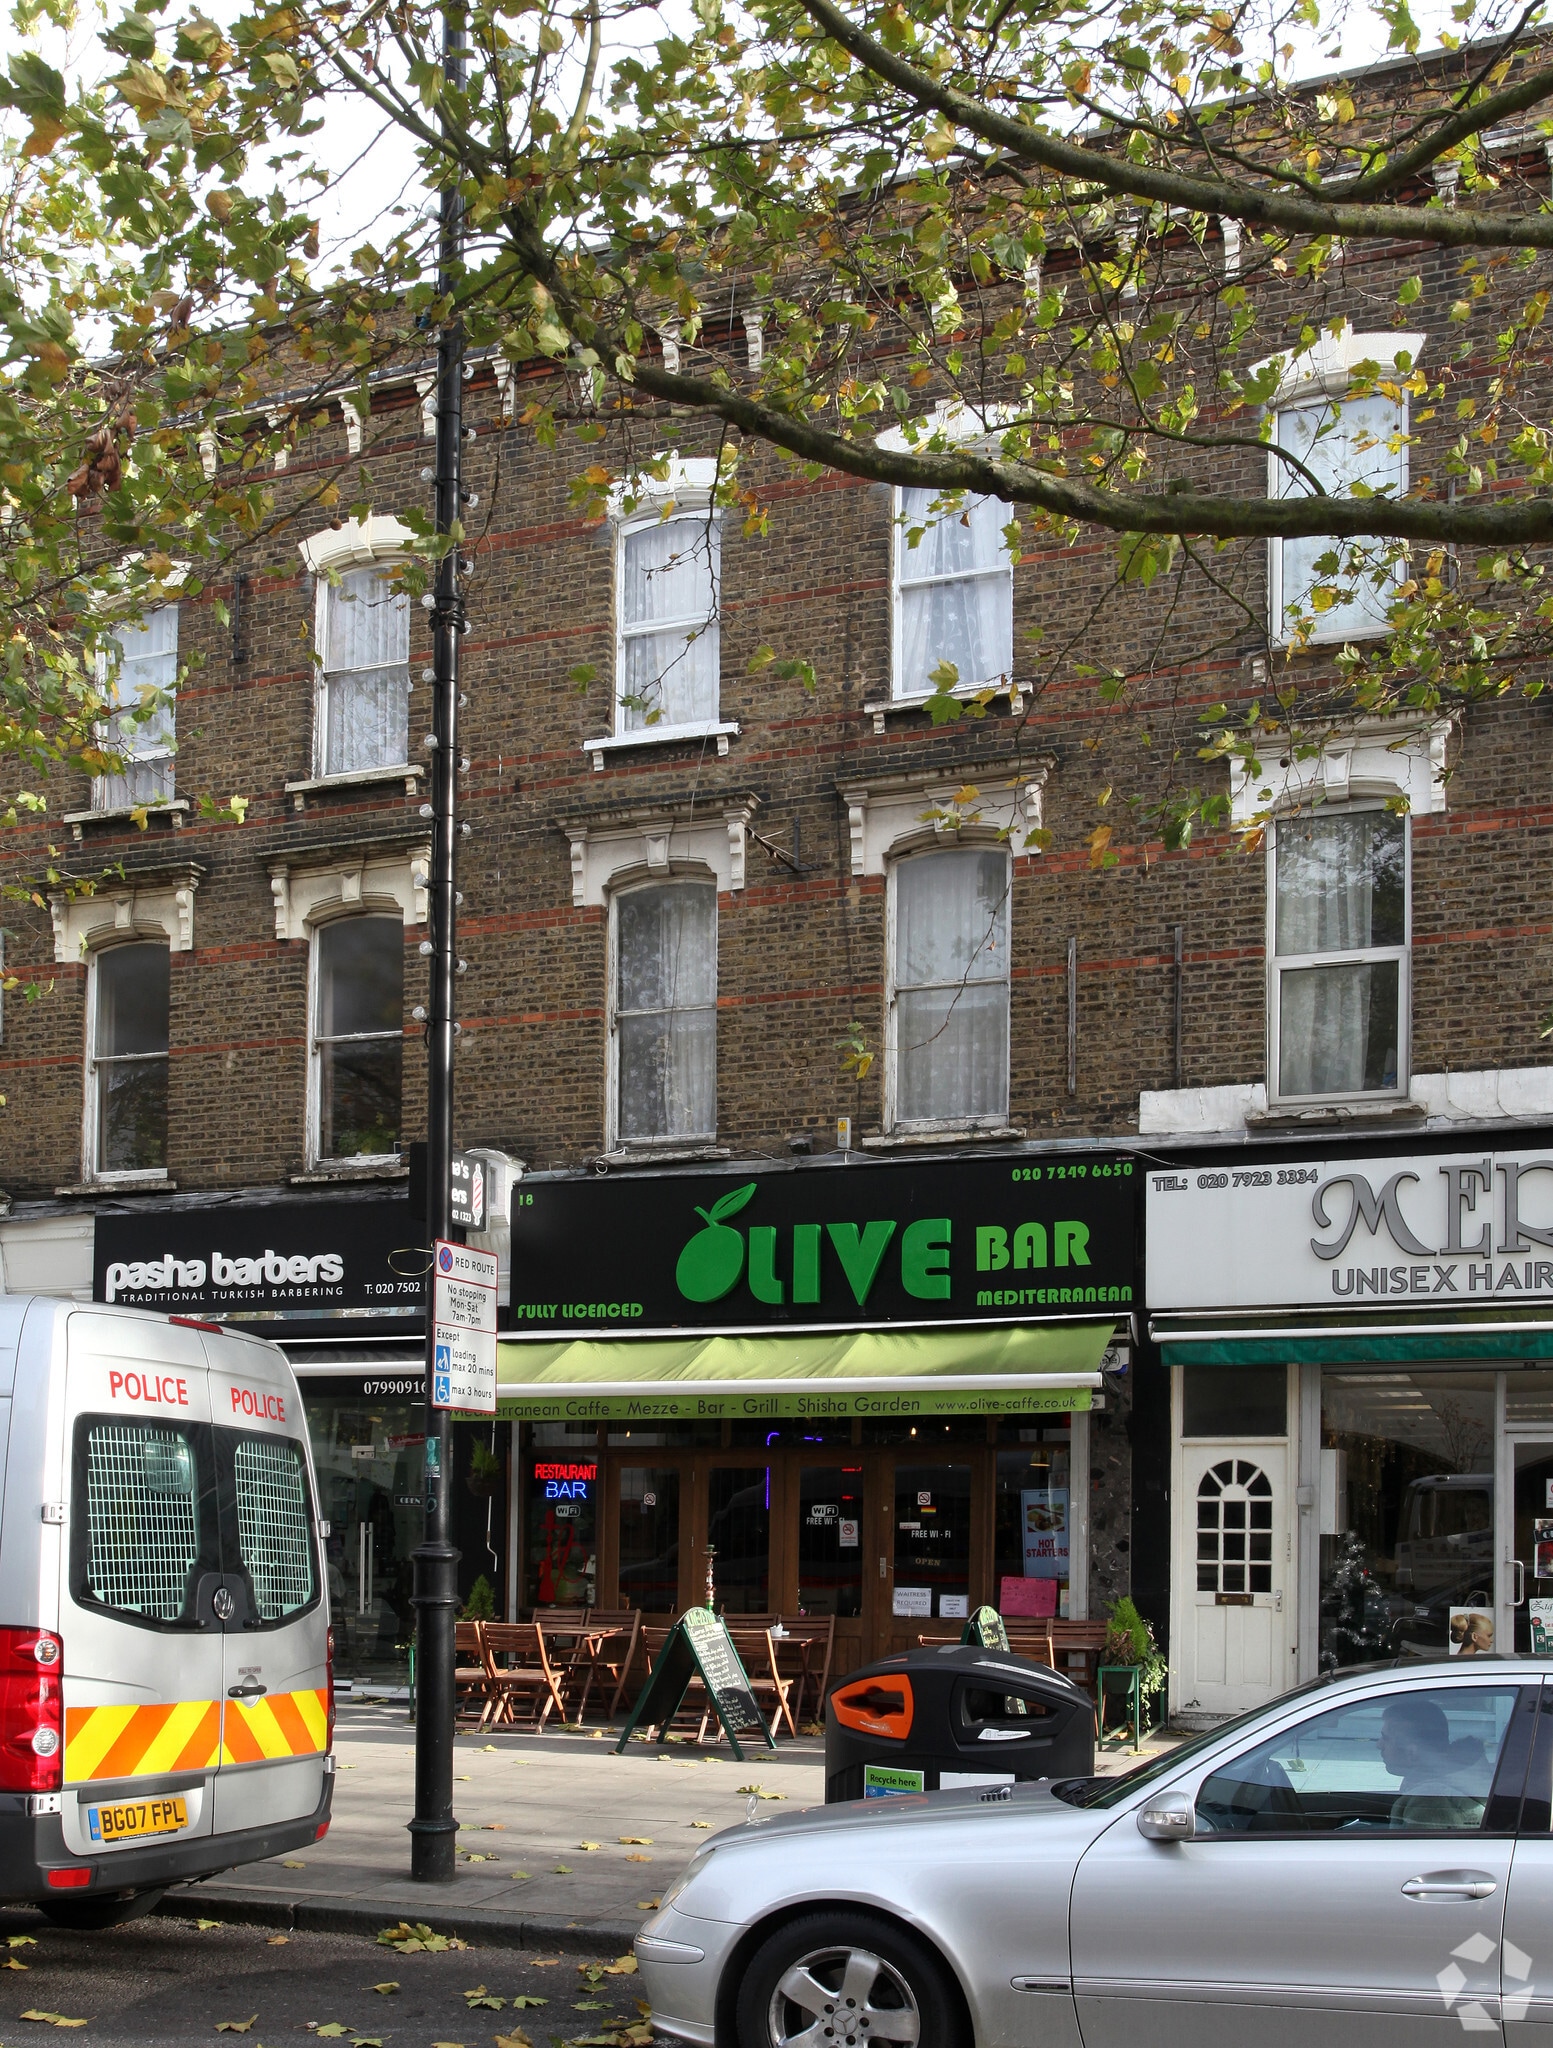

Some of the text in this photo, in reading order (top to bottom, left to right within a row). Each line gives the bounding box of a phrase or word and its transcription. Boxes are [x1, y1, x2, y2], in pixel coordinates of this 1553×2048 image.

[1012, 1163, 1133, 1182] 020 7249 6650
[1152, 1168, 1318, 1192] TEL: 020 7923 3334
[519, 1194, 533, 1206] 18
[460, 1211, 472, 1222] 1323
[676, 1205, 1092, 1307] OLIVE BAR
[455, 1256, 495, 1276] RED ROUTE
[105, 1249, 344, 1304] pasha barbers
[1332, 1265, 1458, 1296] UNISEX
[122, 1286, 344, 1303] TRADITIONAL TURKISH BARBERING
[375, 1283, 394, 1294] 020
[396, 1281, 421, 1293] 7502
[447, 1283, 487, 1303] No stopping
[976, 1286, 1133, 1306] MEDITERRANEAN
[450, 1297, 479, 1313] Mon-Sat
[518, 1302, 644, 1319] FULLY LICENCED
[451, 1310, 482, 1326] 7am-7pm
[436, 1328, 461, 1343] Except
[452, 1348, 477, 1363] loading
[452, 1364, 494, 1377] max 20 mins
[109, 1370, 189, 1406] POLICE
[451, 1386, 492, 1399] max 3 hours
[230, 1387, 286, 1423] POLICE
[565, 1401, 610, 1416] Caffe
[627, 1402, 678, 1416] Mezze
[697, 1400, 725, 1414] Bar
[743, 1398, 778, 1413] Grill
[797, 1396, 847, 1413] Shisha
[854, 1395, 920, 1412] Garden
[935, 1396, 1076, 1410] www.olive-caffe.co.uk
[535, 1463, 598, 1480] RESTAURANT
[546, 1481, 587, 1499] BAR
[806, 1517, 822, 1525] FREE
[823, 1517, 833, 1525] WI
[911, 1530, 928, 1538] FREE
[929, 1530, 939, 1538] WI
[944, 1530, 951, 1538] FI
[1038, 1538, 1055, 1549] HOT
[1026, 1547, 1069, 1558] STARTERS
[915, 1557, 941, 1566] OPEN
[870, 1773, 917, 1787] Recycle here
[101, 1801, 185, 1833] BG07 FPL
